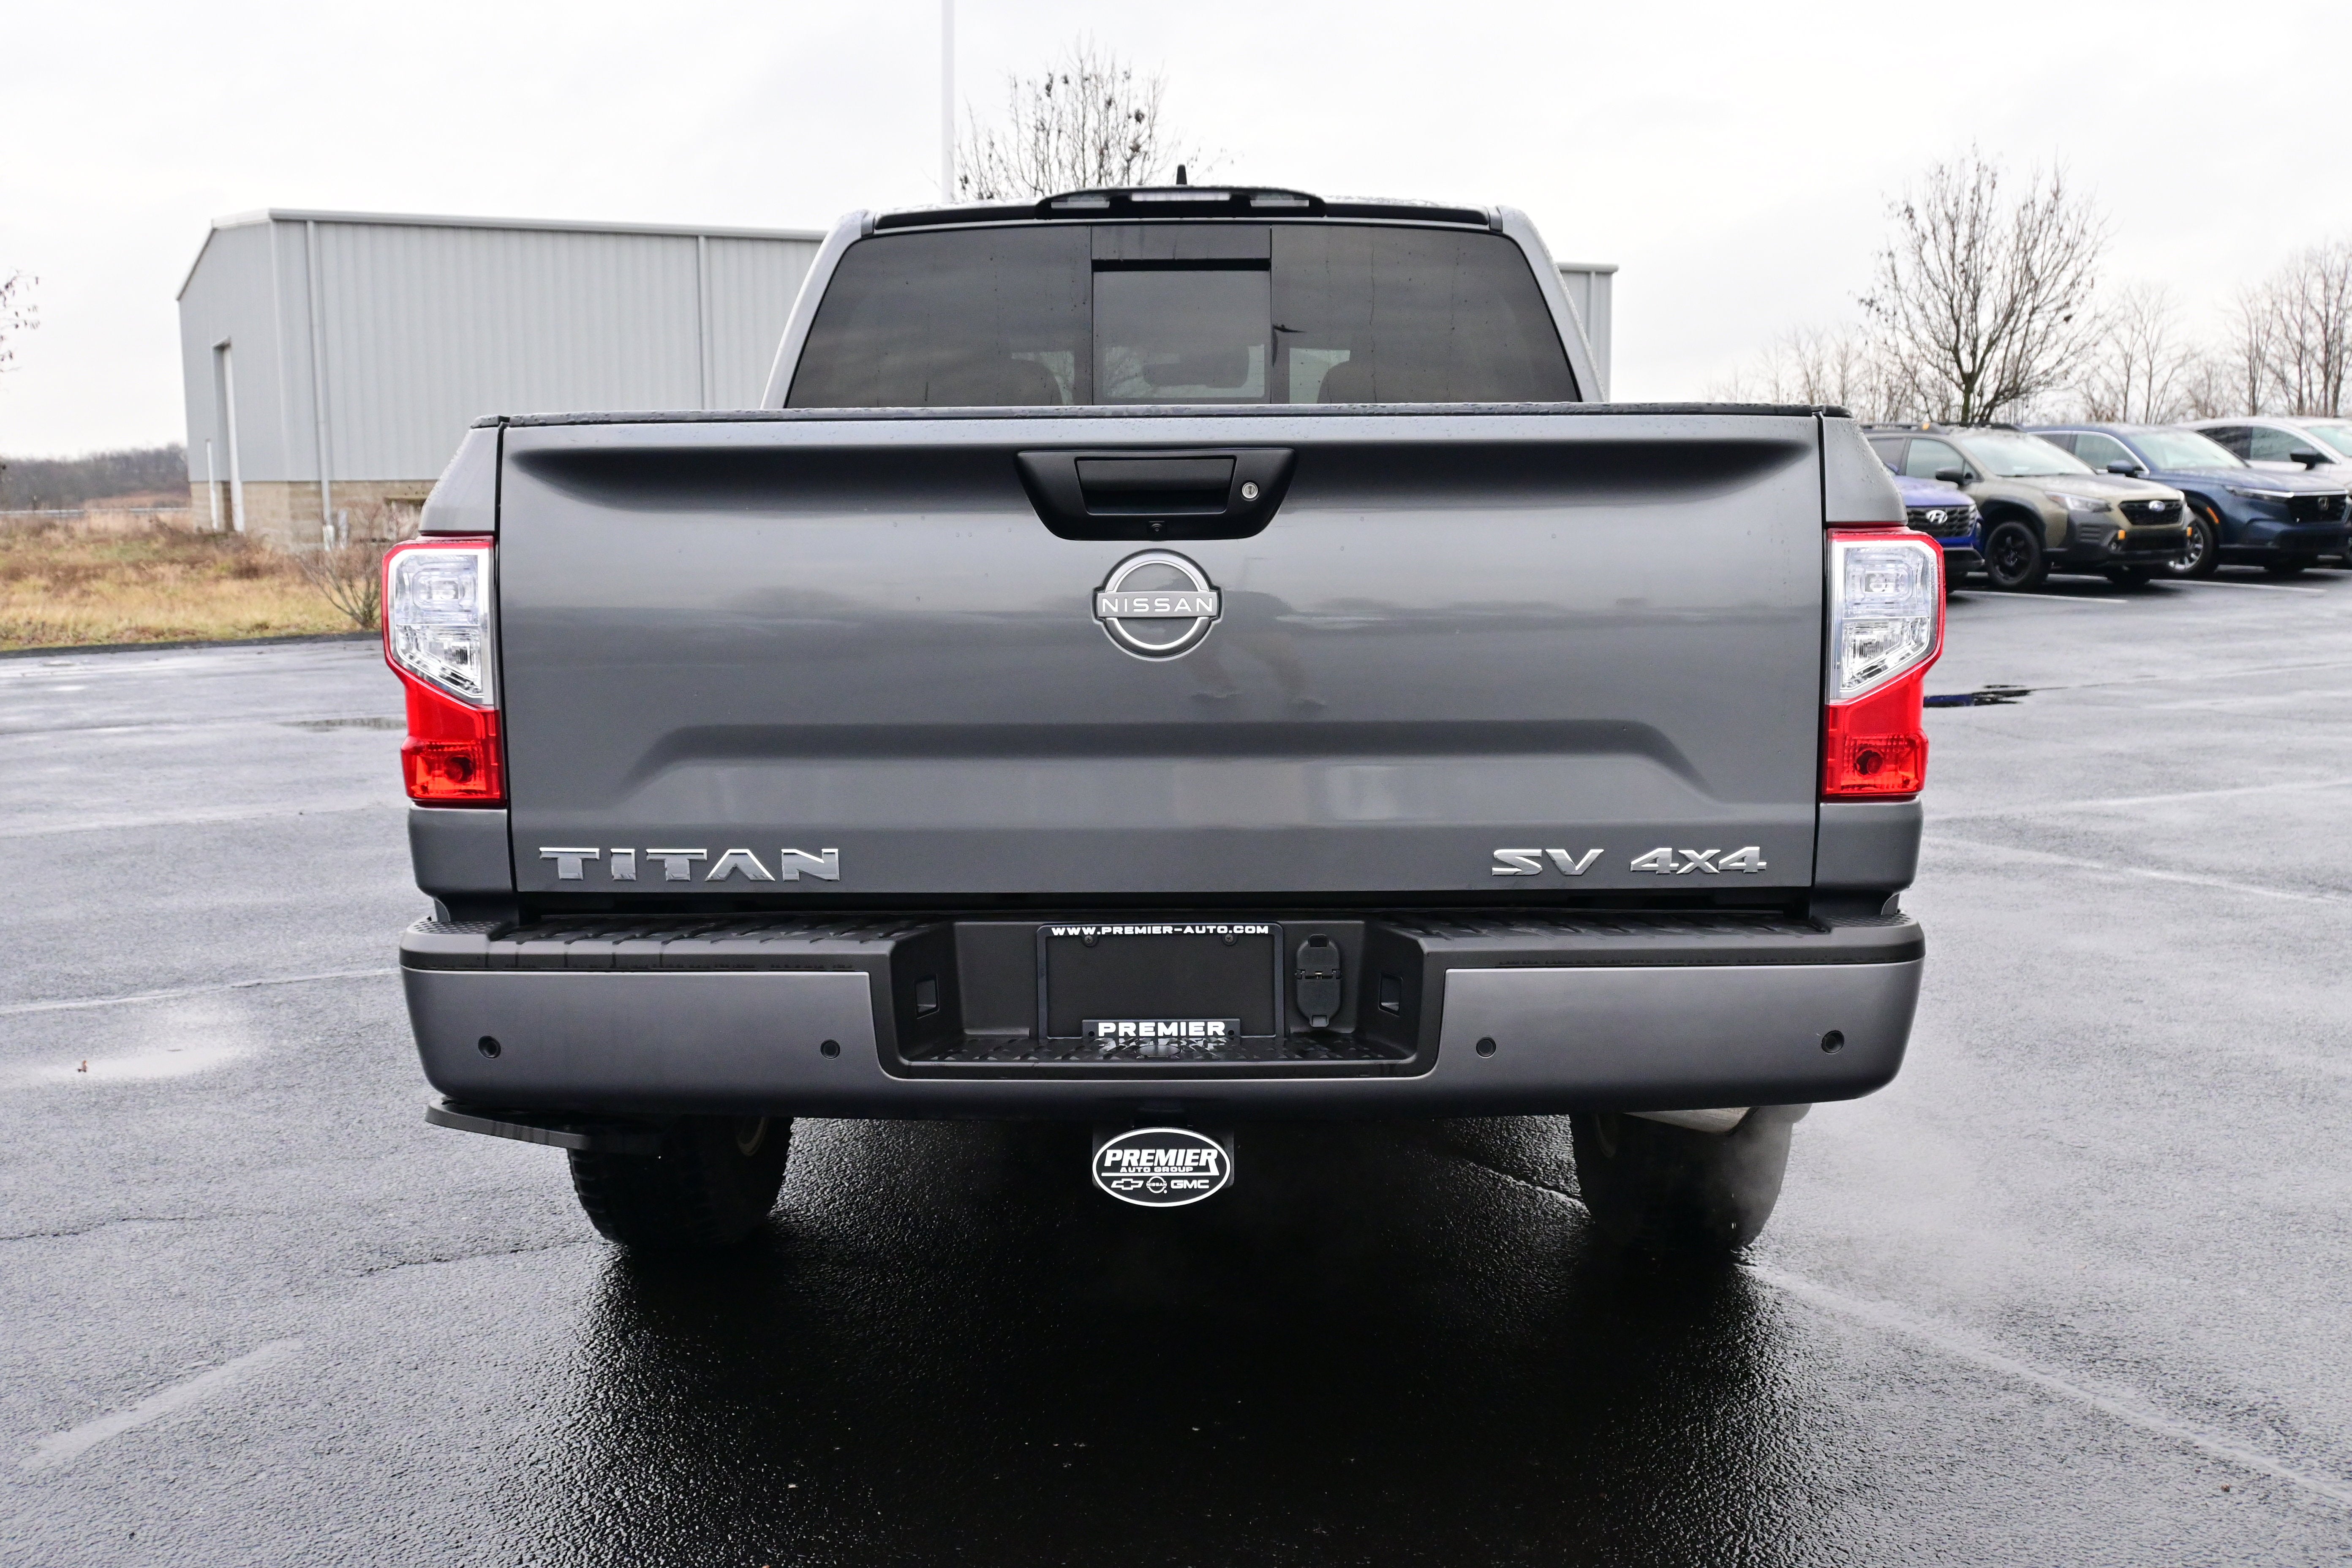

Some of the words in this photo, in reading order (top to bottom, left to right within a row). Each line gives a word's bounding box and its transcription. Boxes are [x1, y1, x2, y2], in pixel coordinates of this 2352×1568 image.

[1102, 597, 1213, 612] NISSAN
[539, 847, 840, 882] TITAN
[1492, 849, 1604, 876] SV
[1051, 925, 1269, 936] WWW.PREMIER-AUTO.COM
[1098, 1021, 1225, 1037] PREMIER
[1104, 1149, 1219, 1168] PREMIER
[1171, 1179, 1209, 1189] GMC
